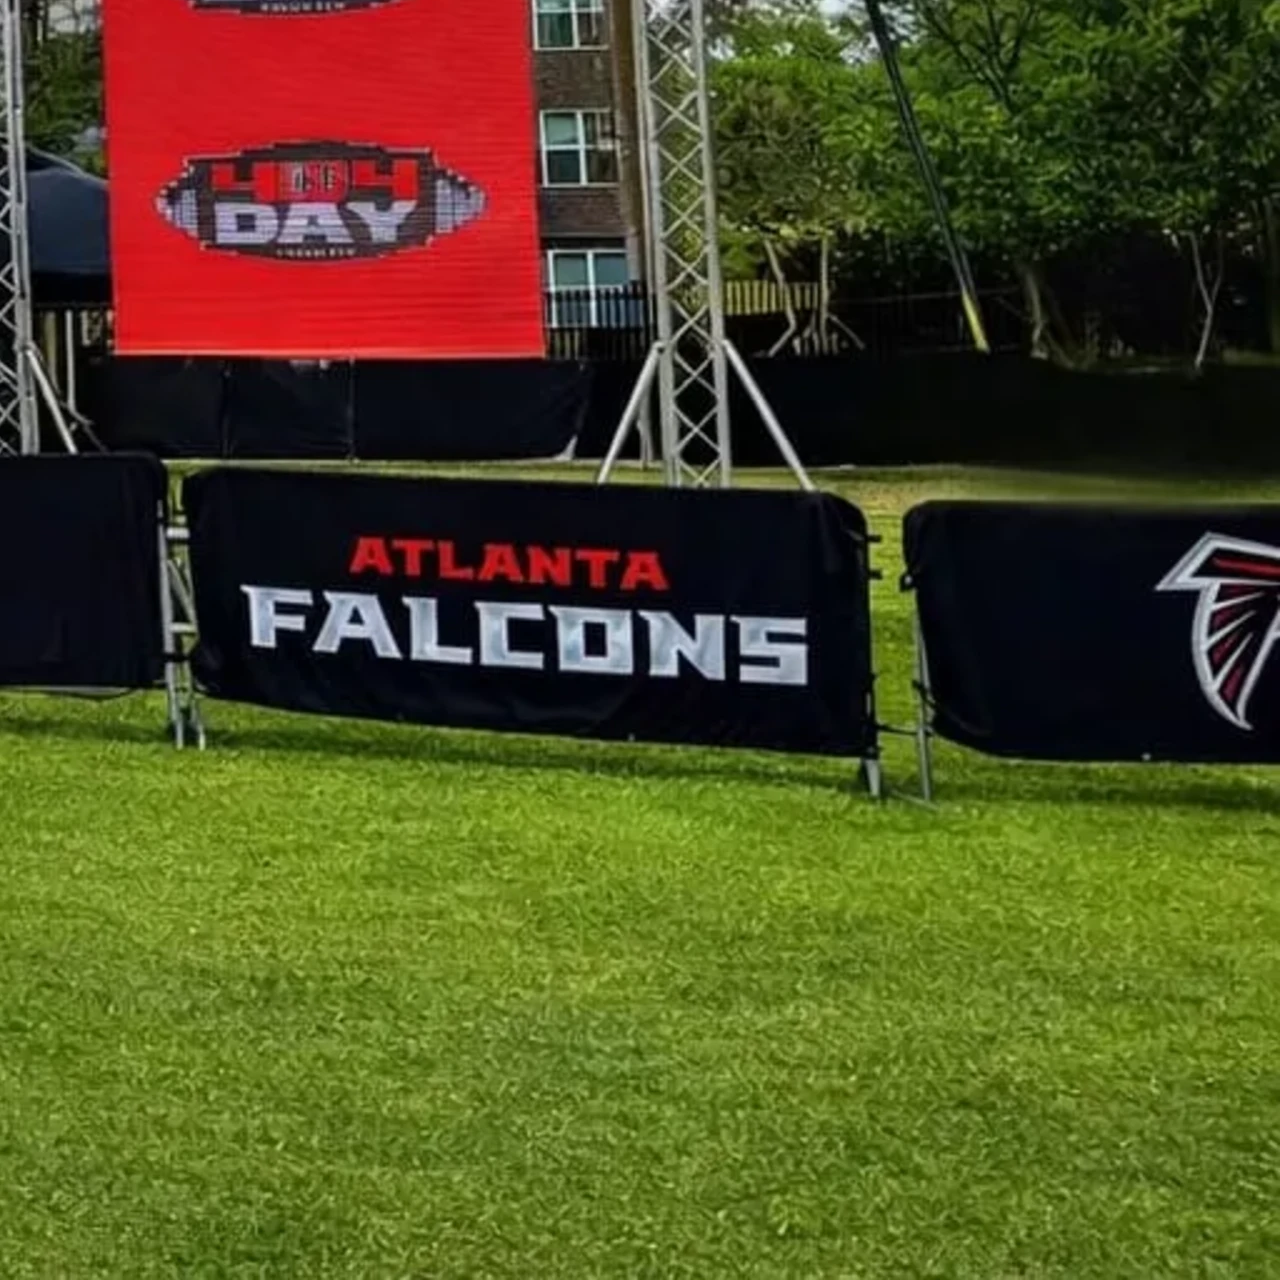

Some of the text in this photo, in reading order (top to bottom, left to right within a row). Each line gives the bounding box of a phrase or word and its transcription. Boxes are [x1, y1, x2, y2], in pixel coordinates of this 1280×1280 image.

[213, 199, 418, 245] DAY
[349, 536, 668, 590] ATLANTA
[240, 584, 808, 686] FALCONS
